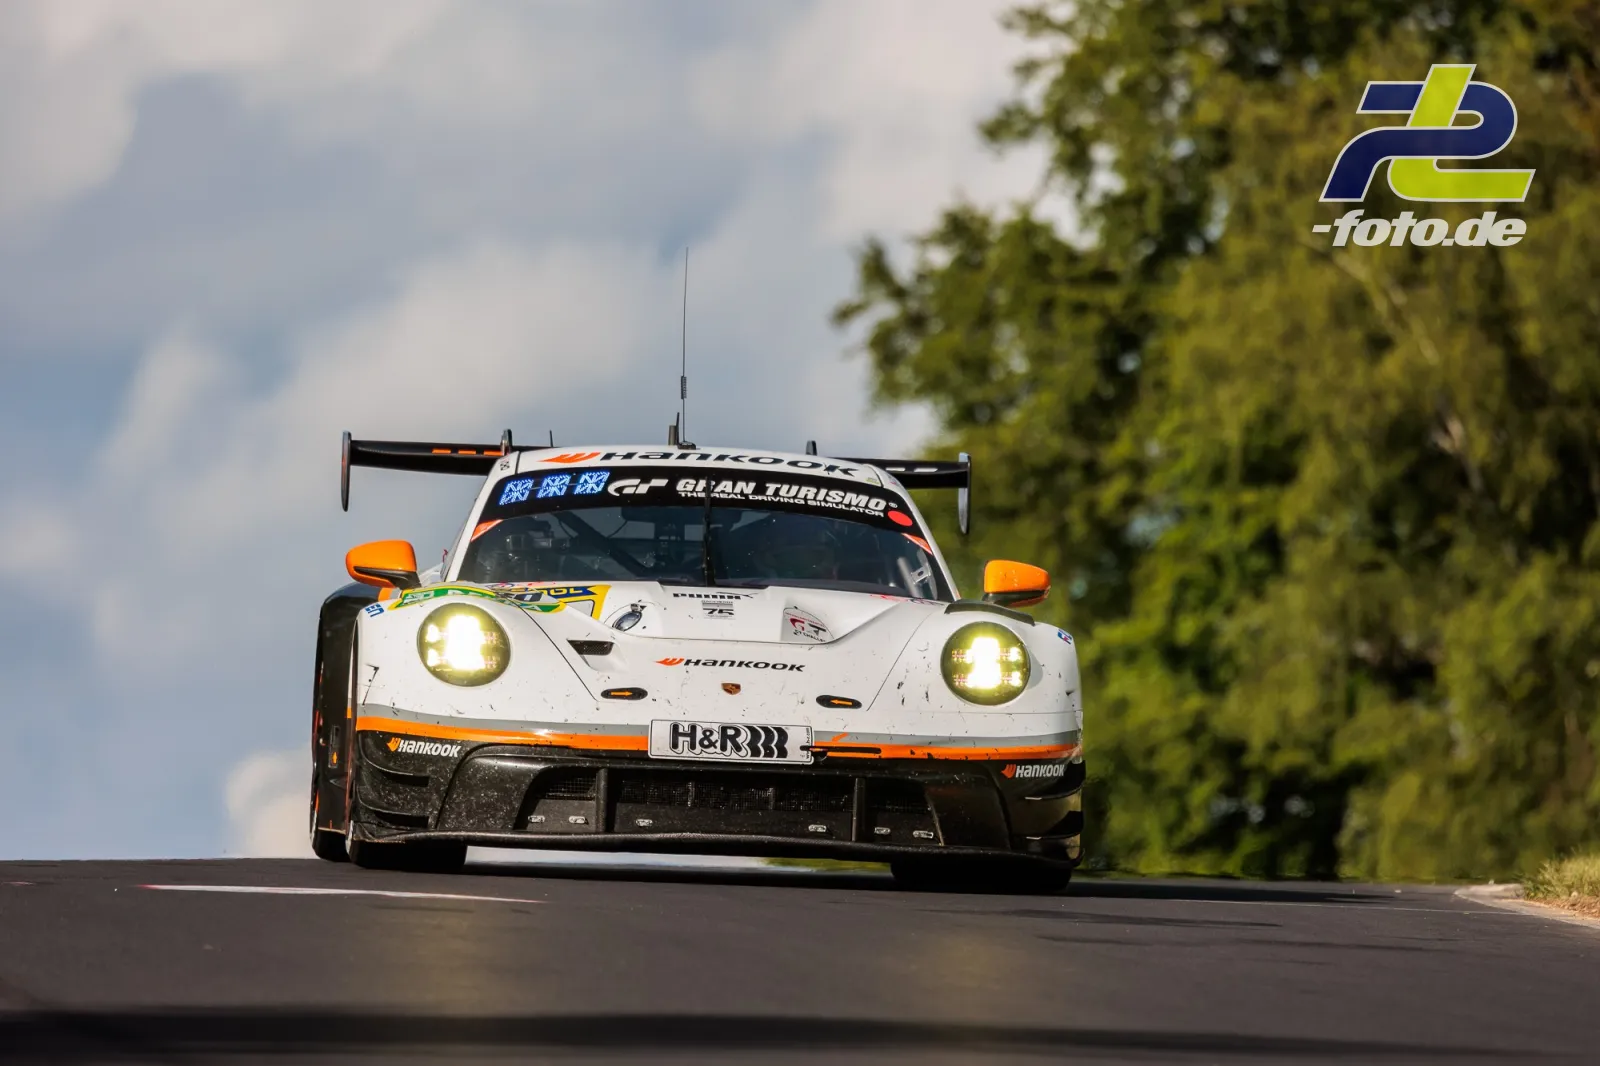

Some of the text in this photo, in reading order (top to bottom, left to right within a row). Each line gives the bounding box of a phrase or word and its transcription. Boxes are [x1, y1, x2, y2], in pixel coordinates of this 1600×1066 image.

[607, 479, 669, 497] GT
[676, 478, 757, 495] GRAN
[710, 492, 746, 500] REAL
[748, 495, 806, 505] DRIVING
[808, 500, 885, 518] SIMULATOR
[670, 723, 748, 757] H&R
